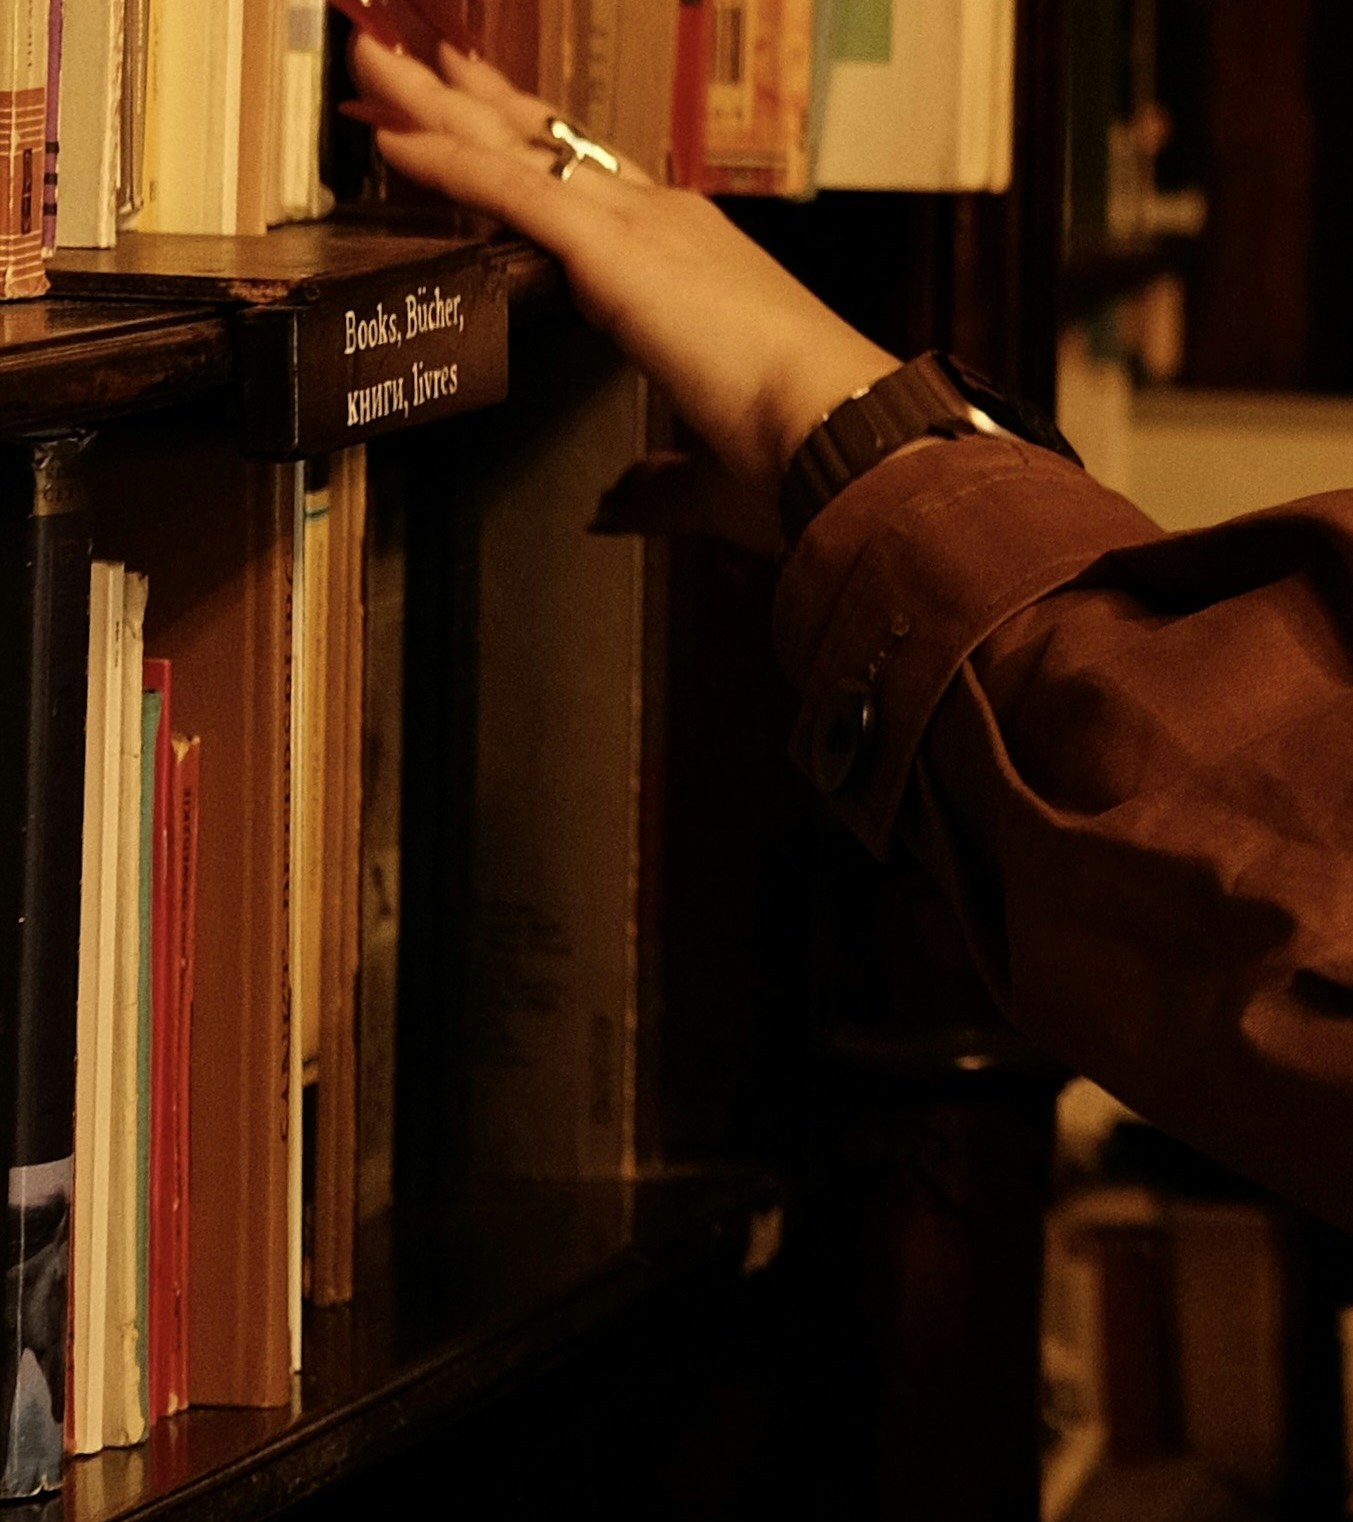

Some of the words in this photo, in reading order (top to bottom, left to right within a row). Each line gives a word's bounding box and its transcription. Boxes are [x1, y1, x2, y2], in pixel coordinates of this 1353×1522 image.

[344, 302, 402, 355] Books,
[405, 285, 465, 341] Bücher,
[346, 376, 410, 427] книги,
[411, 360, 459, 408] livres
